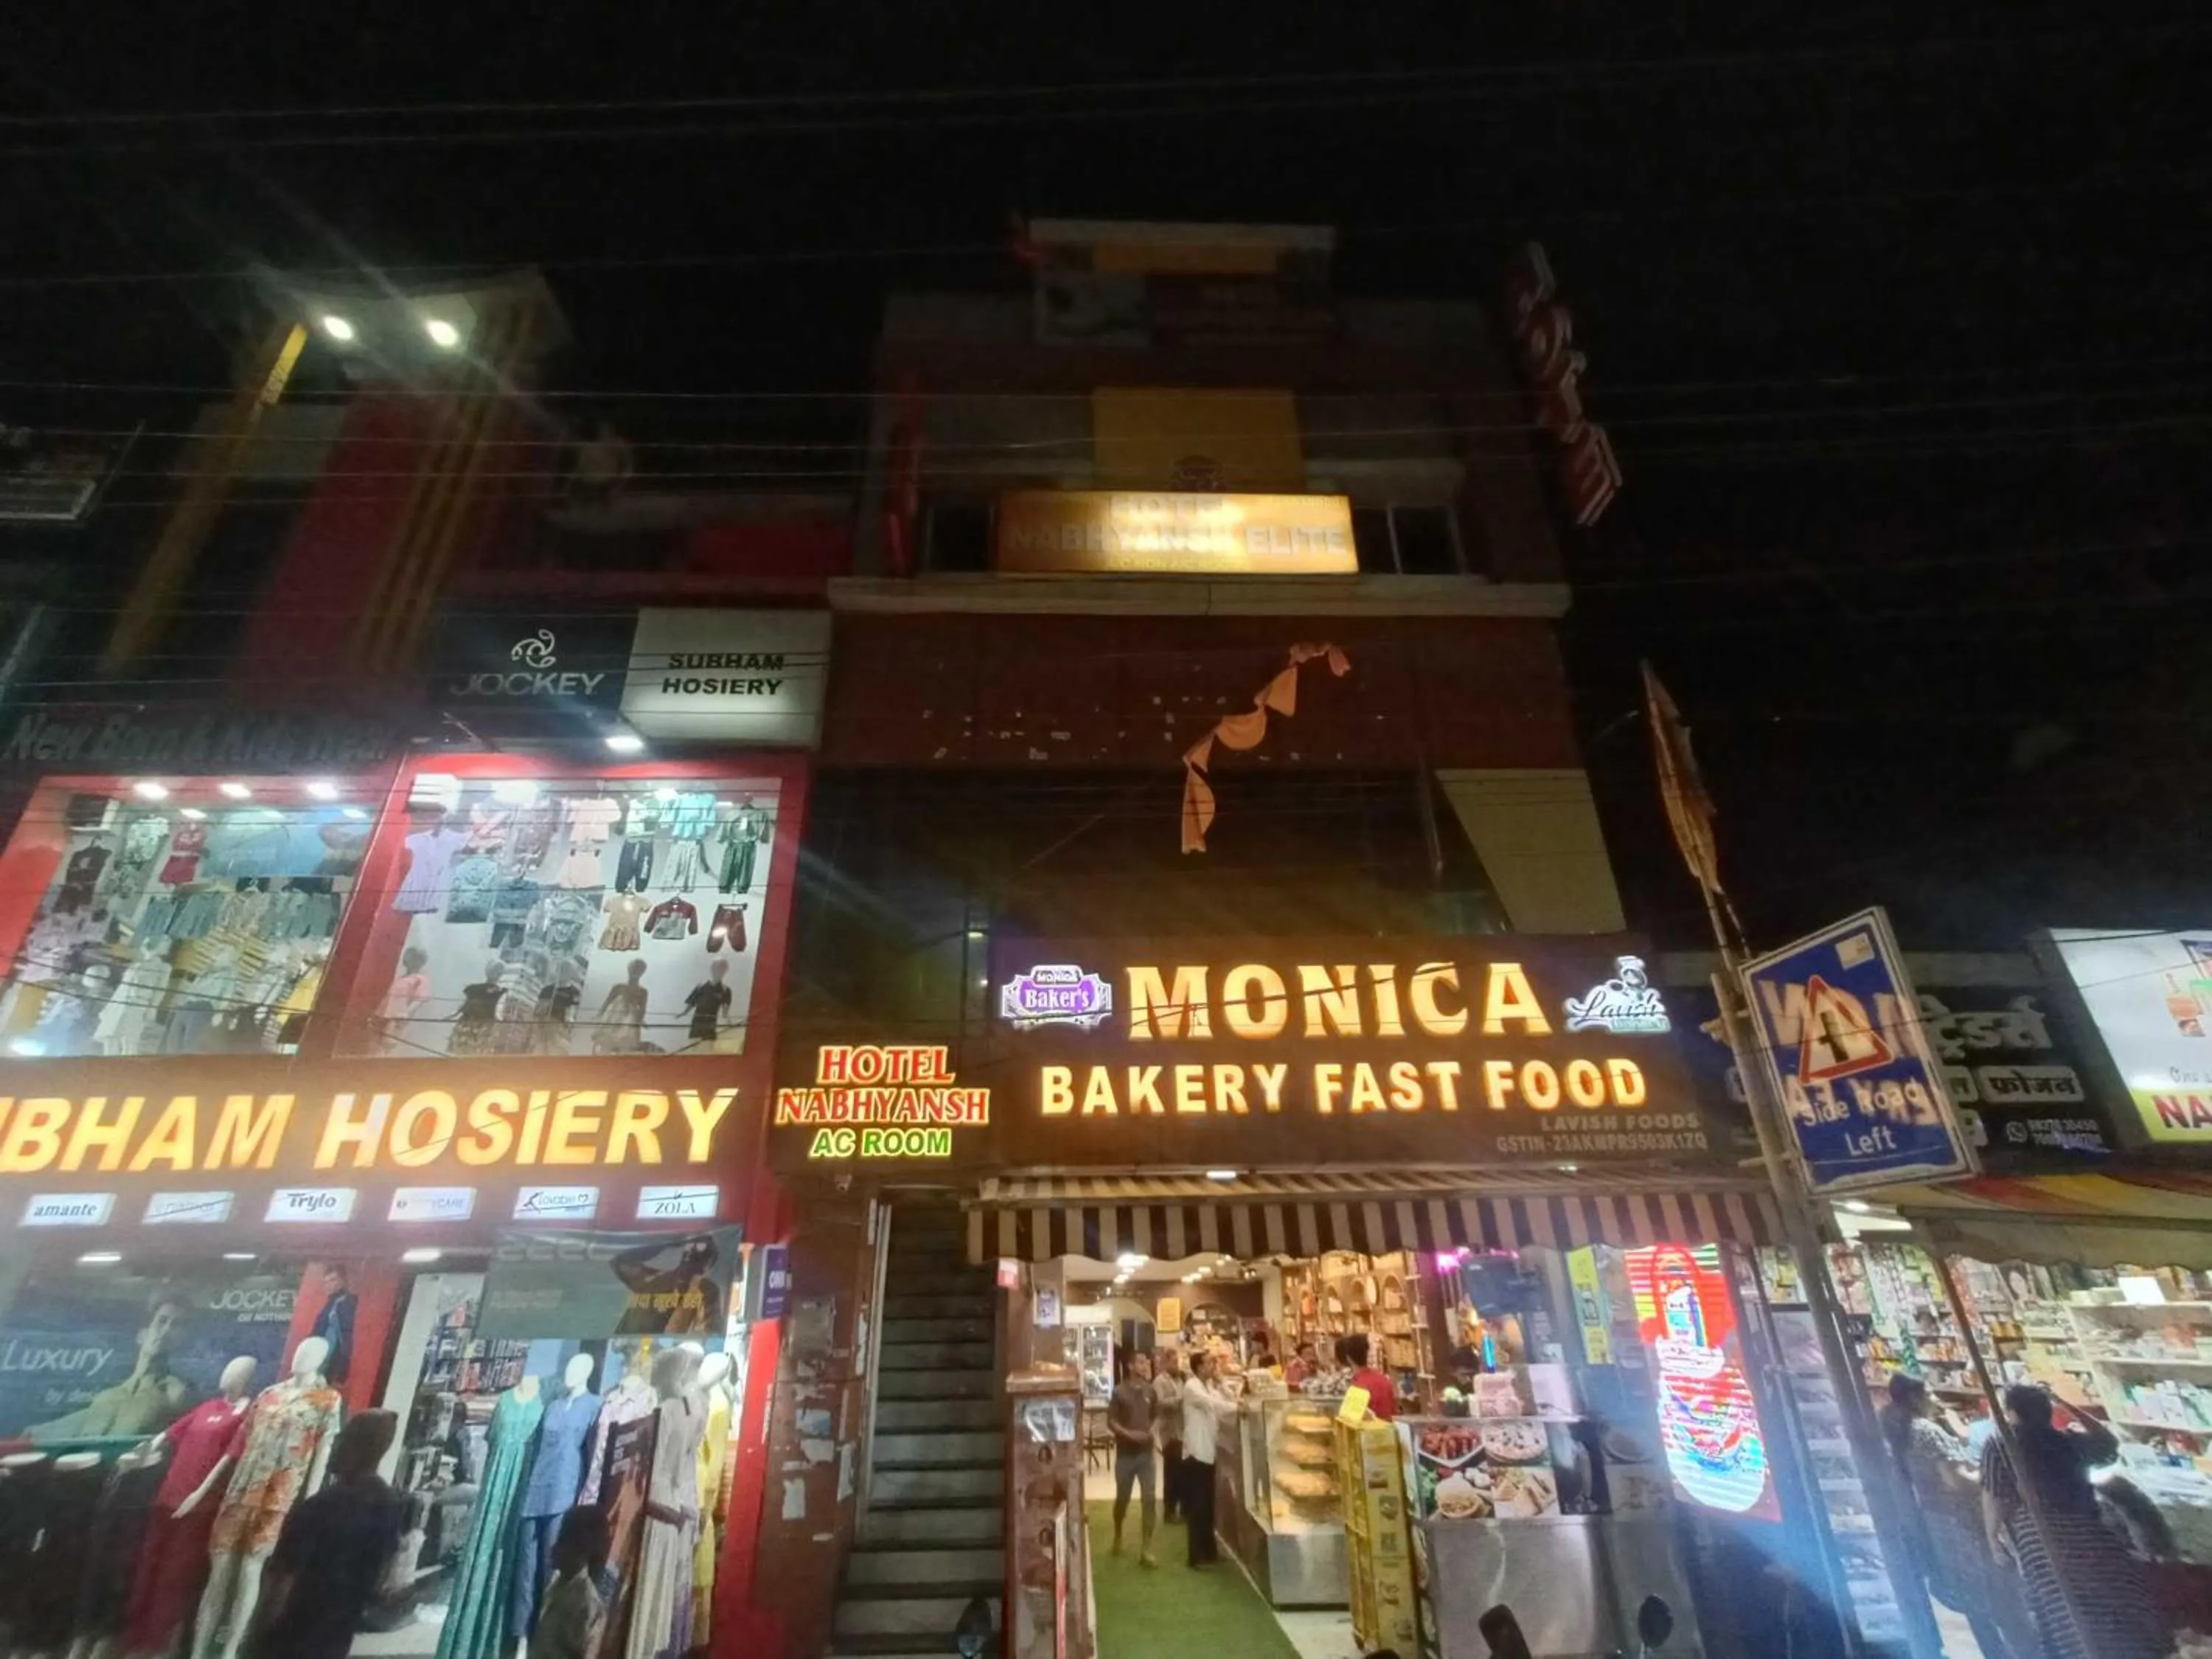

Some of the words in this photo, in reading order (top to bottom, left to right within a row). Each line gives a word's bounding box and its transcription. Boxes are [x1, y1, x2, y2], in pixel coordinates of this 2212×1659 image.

[1246, 526, 1346, 554] ELITE
[668, 653, 785, 670] SUBHAM
[448, 672, 604, 695] JOCKEY
[661, 677, 782, 695] HOSIERY
[1023, 988, 1090, 1009] Baker's
[1126, 961, 1553, 1041] MONICA
[816, 1045, 956, 1084] HOTEL
[1040, 1063, 1289, 1115] BAKERY
[1314, 1061, 1461, 1113] FAST
[1483, 1057, 1648, 1110] FOOD
[775, 1088, 990, 1124] NABHYANSH
[1803, 1099, 1851, 1127] Side
[1859, 1075, 1920, 1116] Road
[2151, 1093, 2212, 1130] NA
[312, 1088, 739, 1170] HOSIERY
[1542, 1115, 1618, 1131] LAVISH
[1625, 1112, 1700, 1130] FOODS
[810, 1128, 855, 1156] AC
[860, 1128, 952, 1156] ROOM
[1845, 1124, 1897, 1156] Left
[33, 1203, 97, 1217] amante
[288, 1193, 337, 1211] Trylo
[654, 1202, 696, 1214] ZOLA
[2, 1340, 114, 1377] Luxury
